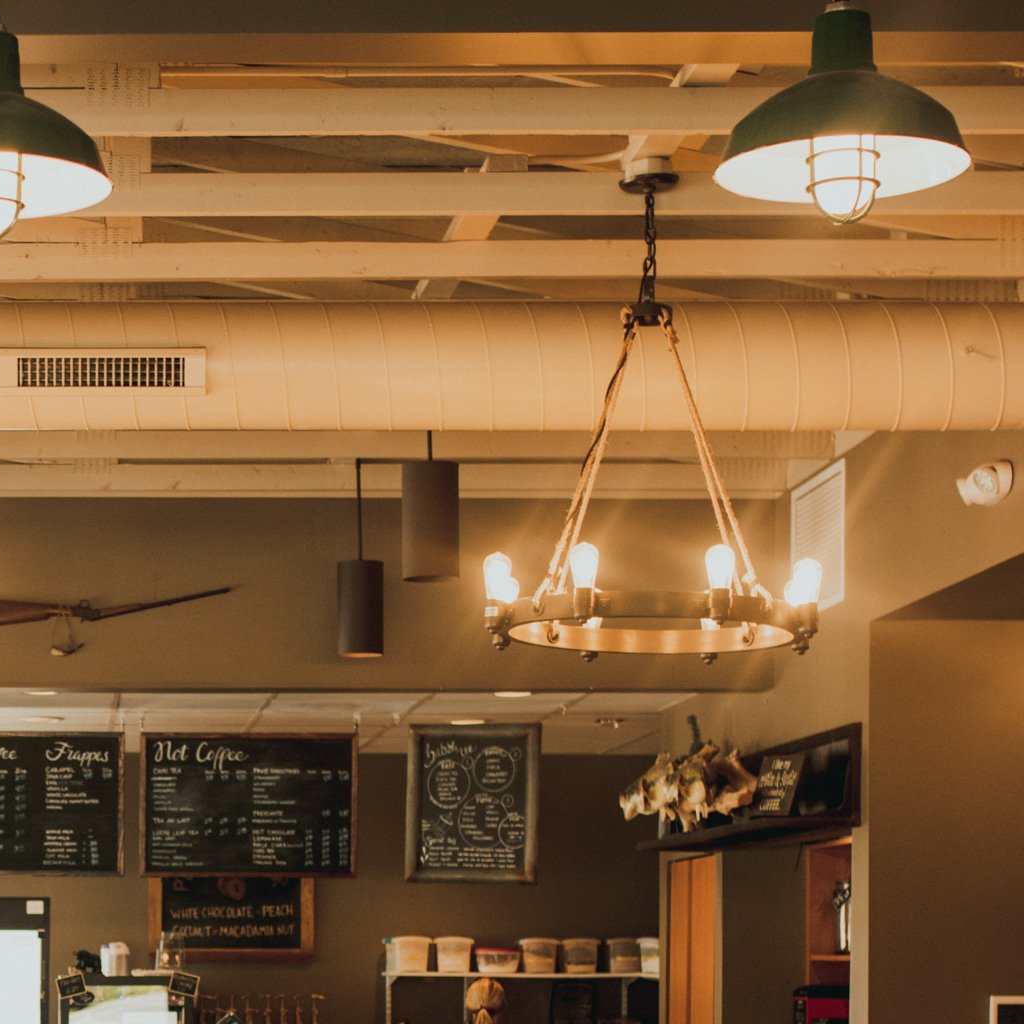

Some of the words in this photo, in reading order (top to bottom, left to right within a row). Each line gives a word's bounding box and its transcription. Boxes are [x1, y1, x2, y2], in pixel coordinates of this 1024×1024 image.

[45, 741, 110, 767] Frappes
[153, 740, 190, 763] Not
[196, 741, 250, 770] Coffee
[170, 907, 201, 920] WHITE
[201, 905, 254, 919] CHOCOLATE
[261, 904, 294, 917] PEACH
[172, 924, 211, 937] COCONUT
[219, 924, 275, 938] MACADAMIA
[277, 924, 296, 936] NUT
